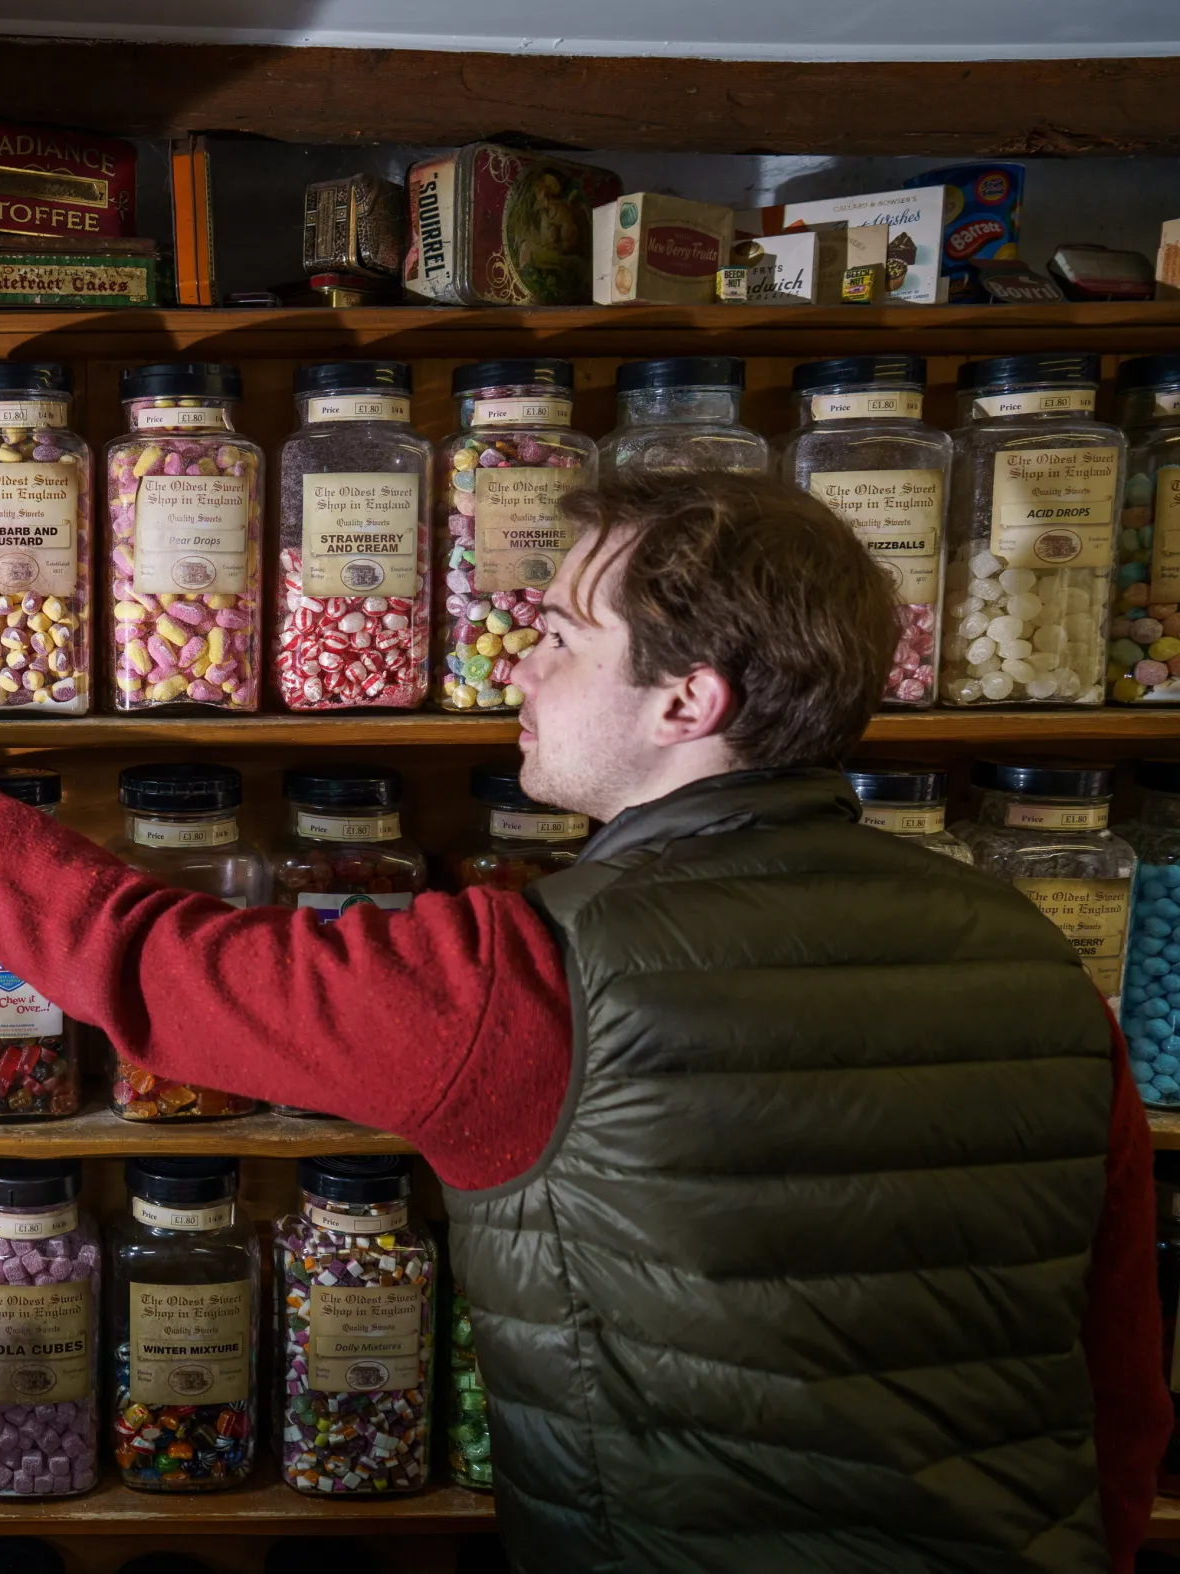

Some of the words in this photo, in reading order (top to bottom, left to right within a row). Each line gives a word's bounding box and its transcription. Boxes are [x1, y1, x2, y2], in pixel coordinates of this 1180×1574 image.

[951, 220, 1001, 251] Barratt
[648, 238, 664, 252] New
[667, 240, 691, 260] Berry
[692, 242, 718, 261] Fruits
[724, 270, 745, 279] BEECH
[754, 265, 783, 275] FRY'S
[846, 269, 870, 278] BEECH
[71, 277, 129, 293] Cakes
[725, 279, 741, 287] -NUT
[990, 282, 1059, 299] Bovril
[1044, 399, 1067, 407] £1.80
[3, 410, 24, 420] £1.80
[32, 474, 69, 487] Sweet
[2, 488, 13, 500] in
[18, 488, 67, 502] England
[18, 509, 44, 518] Sweets
[1027, 509, 1053, 518] ACID
[1056, 508, 1090, 517] DROPS
[35, 527, 58, 535] AND
[170, 537, 191, 545] Pear
[194, 537, 220, 547] Drops
[321, 535, 403, 543] STRAWBERRY
[327, 544, 352, 552] AND
[357, 544, 398, 552] CREAM
[868, 541, 924, 550] FIZZBALLS
[184, 832, 203, 841] £1.80
[27, 995, 35, 1003] it
[32, 1341, 83, 1354] CUBES
[144, 1345, 186, 1354] WINTER
[191, 1344, 239, 1354] MIXTURE
[335, 1343, 360, 1352] Dolly
[362, 1343, 402, 1351] Mixtures
